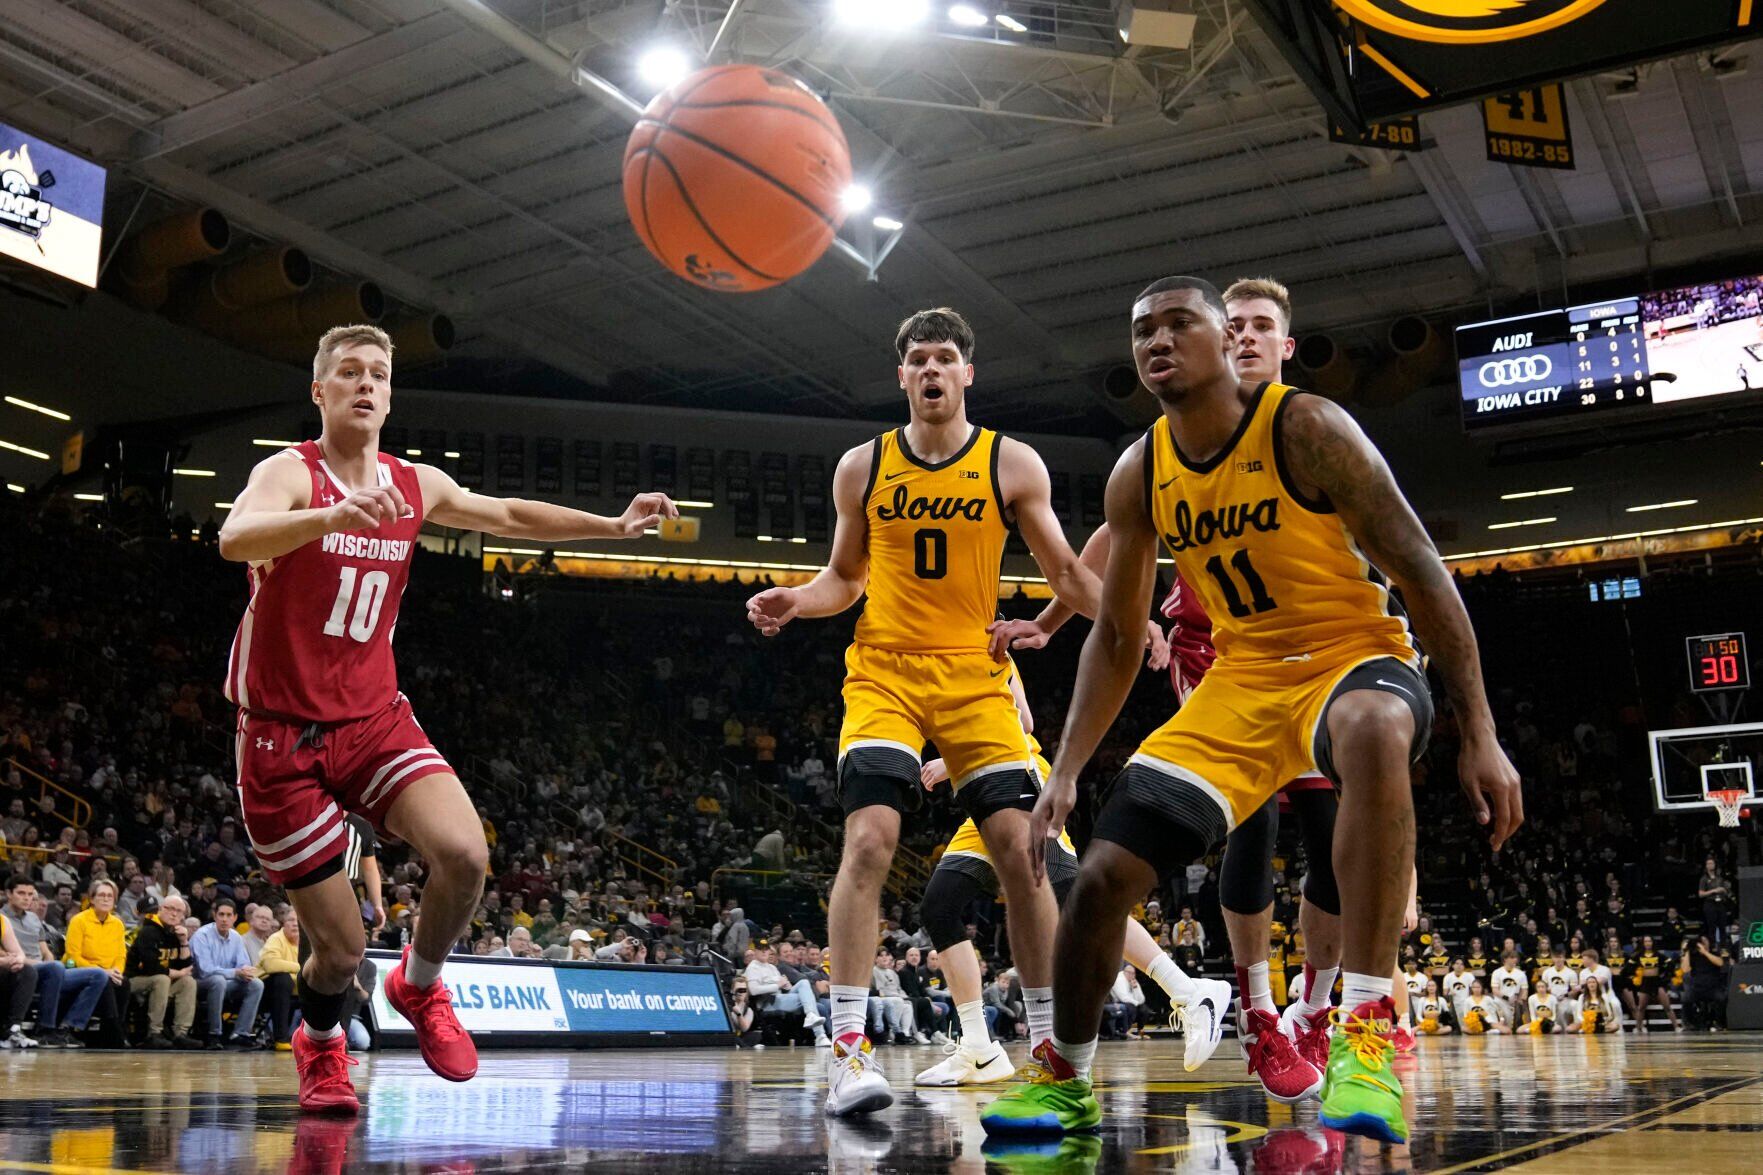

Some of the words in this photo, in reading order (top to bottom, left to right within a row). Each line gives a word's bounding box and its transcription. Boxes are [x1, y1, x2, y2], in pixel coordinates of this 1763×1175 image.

[1490, 137, 1570, 163] 1982-85
[1589, 306, 1617, 318] IOWA
[1492, 332, 1533, 352] AUDI
[1577, 332, 1585, 342] 0
[1608, 327, 1617, 337] 4
[1629, 323, 1636, 334] 1
[1579, 346, 1587, 357] 5
[1609, 341, 1618, 352] 0
[1631, 338, 1638, 349] 1
[1578, 360, 1592, 372] 11
[1611, 356, 1620, 367] 3
[1633, 353, 1640, 364] 1
[1579, 377, 1594, 389] 22
[1614, 373, 1622, 384] 3
[1634, 370, 1643, 381] 0
[1477, 392, 1522, 413] IOWA
[1524, 385, 1562, 405] CITY
[1581, 393, 1597, 405] 30
[1636, 386, 1645, 397] 0
[876, 484, 988, 522] Iowa
[1165, 497, 1281, 553] Iowa
[914, 528, 948, 580] 0
[1205, 548, 1278, 618] 11
[322, 566, 390, 643] 10
[1701, 655, 1738, 685] 30
[486, 984, 551, 1010] BANK
[567, 989, 604, 1009] Your
[605, 989, 644, 1010] bank
[645, 994, 665, 1010] on
[666, 995, 718, 1015] campus
